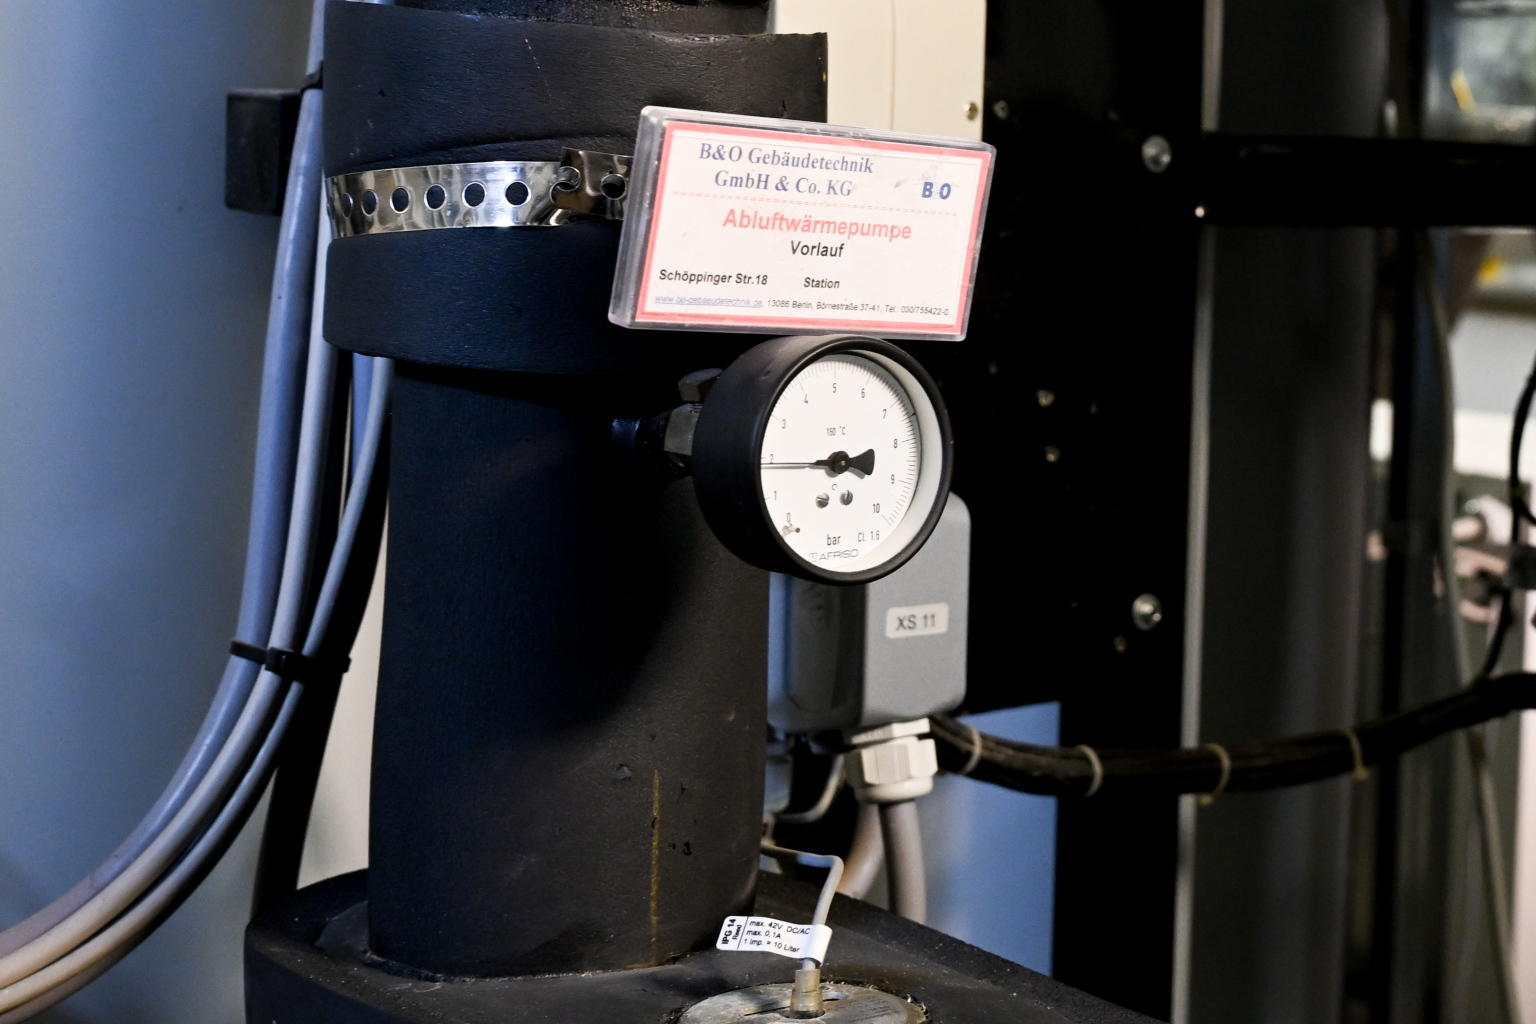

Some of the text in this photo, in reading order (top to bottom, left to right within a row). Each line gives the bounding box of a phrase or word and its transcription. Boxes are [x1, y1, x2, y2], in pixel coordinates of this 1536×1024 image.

[699, 142, 874, 174] B&O Gebäudetechnik
[714, 169, 854, 197] GmbH & Co. KG
[722, 208, 912, 242] Abluftwärmepumpe
[790, 240, 845, 258] Vorlauf
[659, 268, 840, 289] Schöppinger Str.18 Station
[832, 383, 837, 394] 5
[860, 388, 866, 399] 6
[804, 394, 809, 405] 4
[882, 408, 887, 419] 7
[782, 419, 787, 430] 3
[893, 438, 898, 449] 8
[890, 474, 895, 484] 9
[773, 491, 777, 501] 1
[872, 503, 880, 513] 10
[826, 534, 841, 546] bar
[896, 613, 936, 631] XS 11
[721, 918, 737, 945] IPG 14
[749, 920, 811, 935] max. 42V DC/AC
[774, 941, 782, 949] 10
[784, 943, 801, 953] Liter
